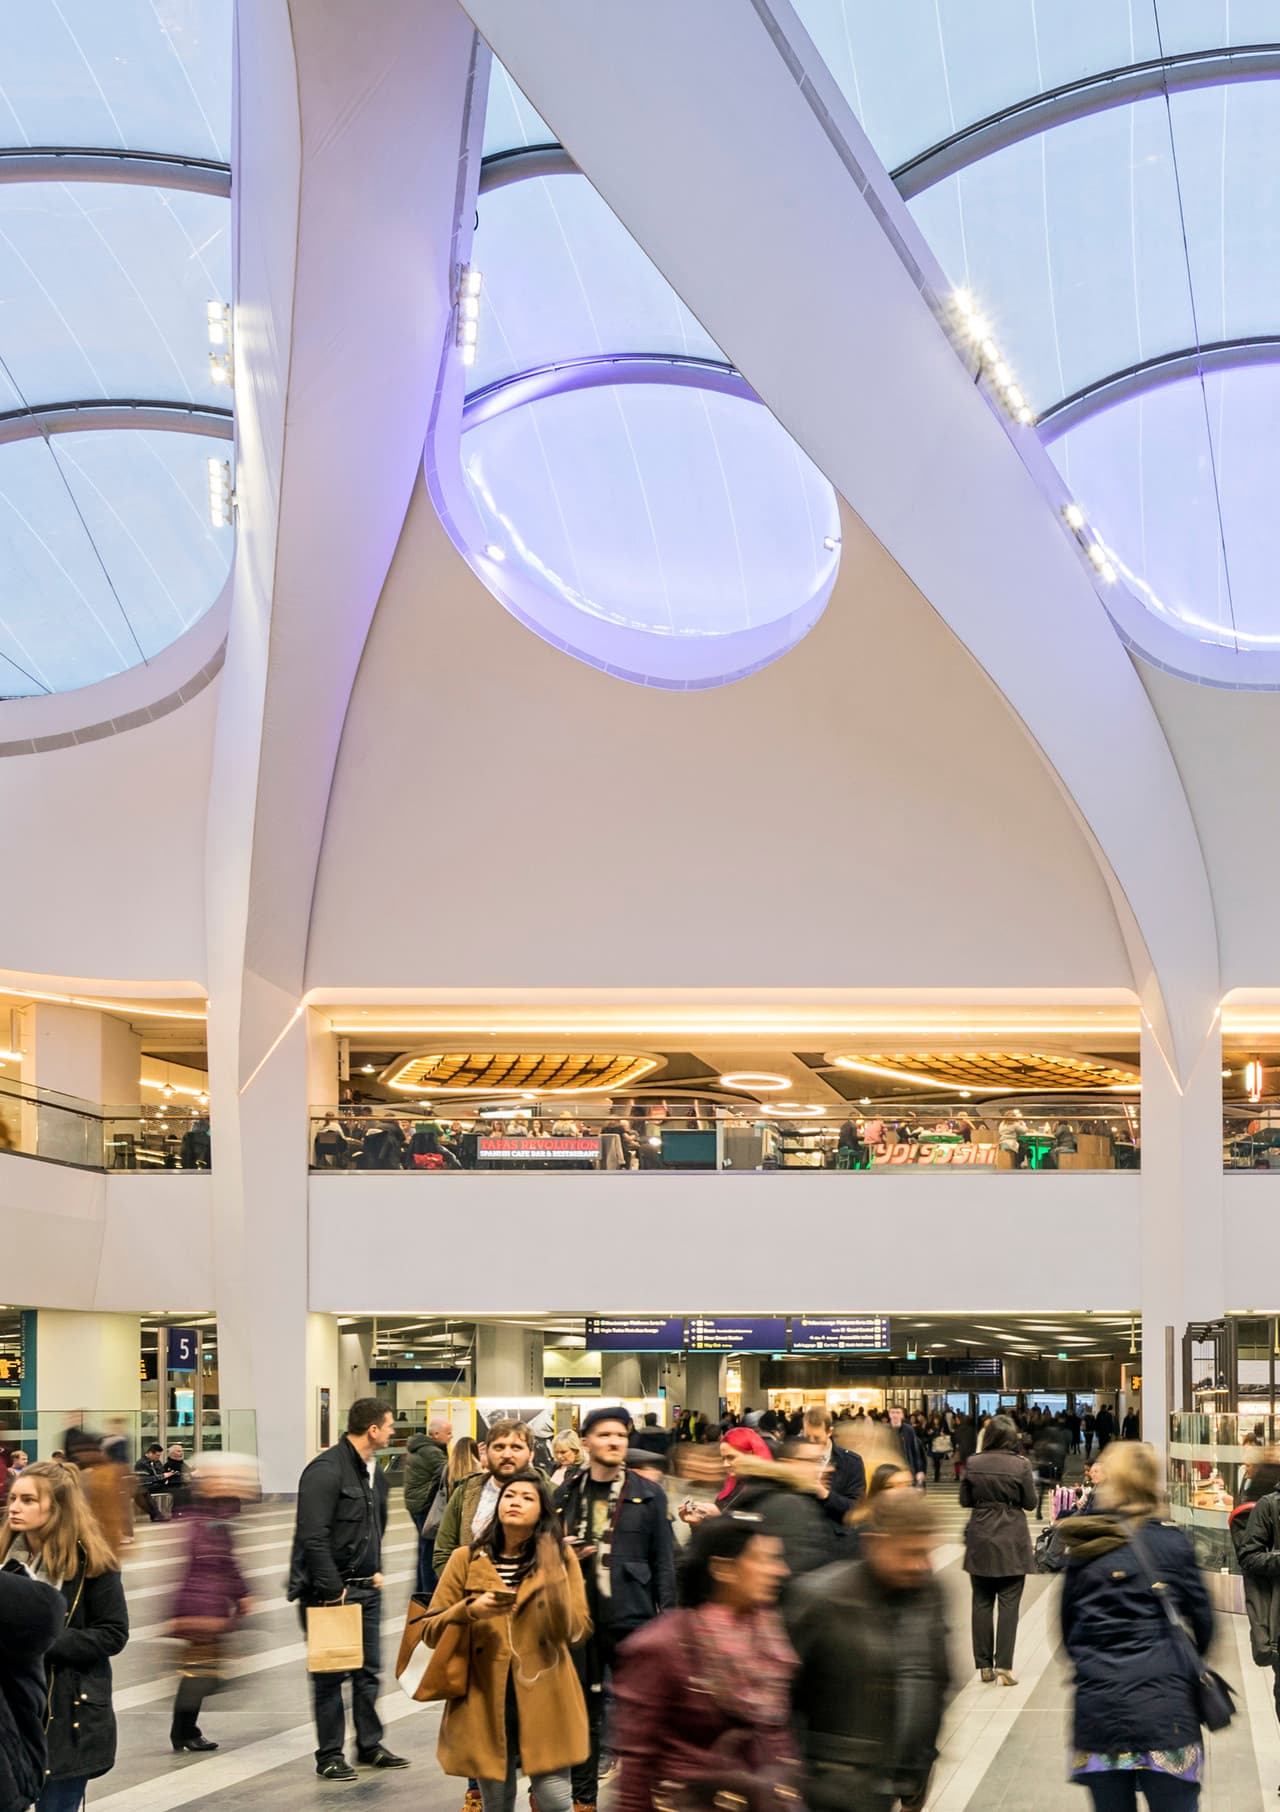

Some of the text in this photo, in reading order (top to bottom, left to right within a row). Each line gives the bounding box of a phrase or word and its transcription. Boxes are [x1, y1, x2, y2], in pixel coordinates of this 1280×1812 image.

[480, 1139, 599, 1150] TAPAS REVOLUTION
[179, 1338, 190, 1360] 5
